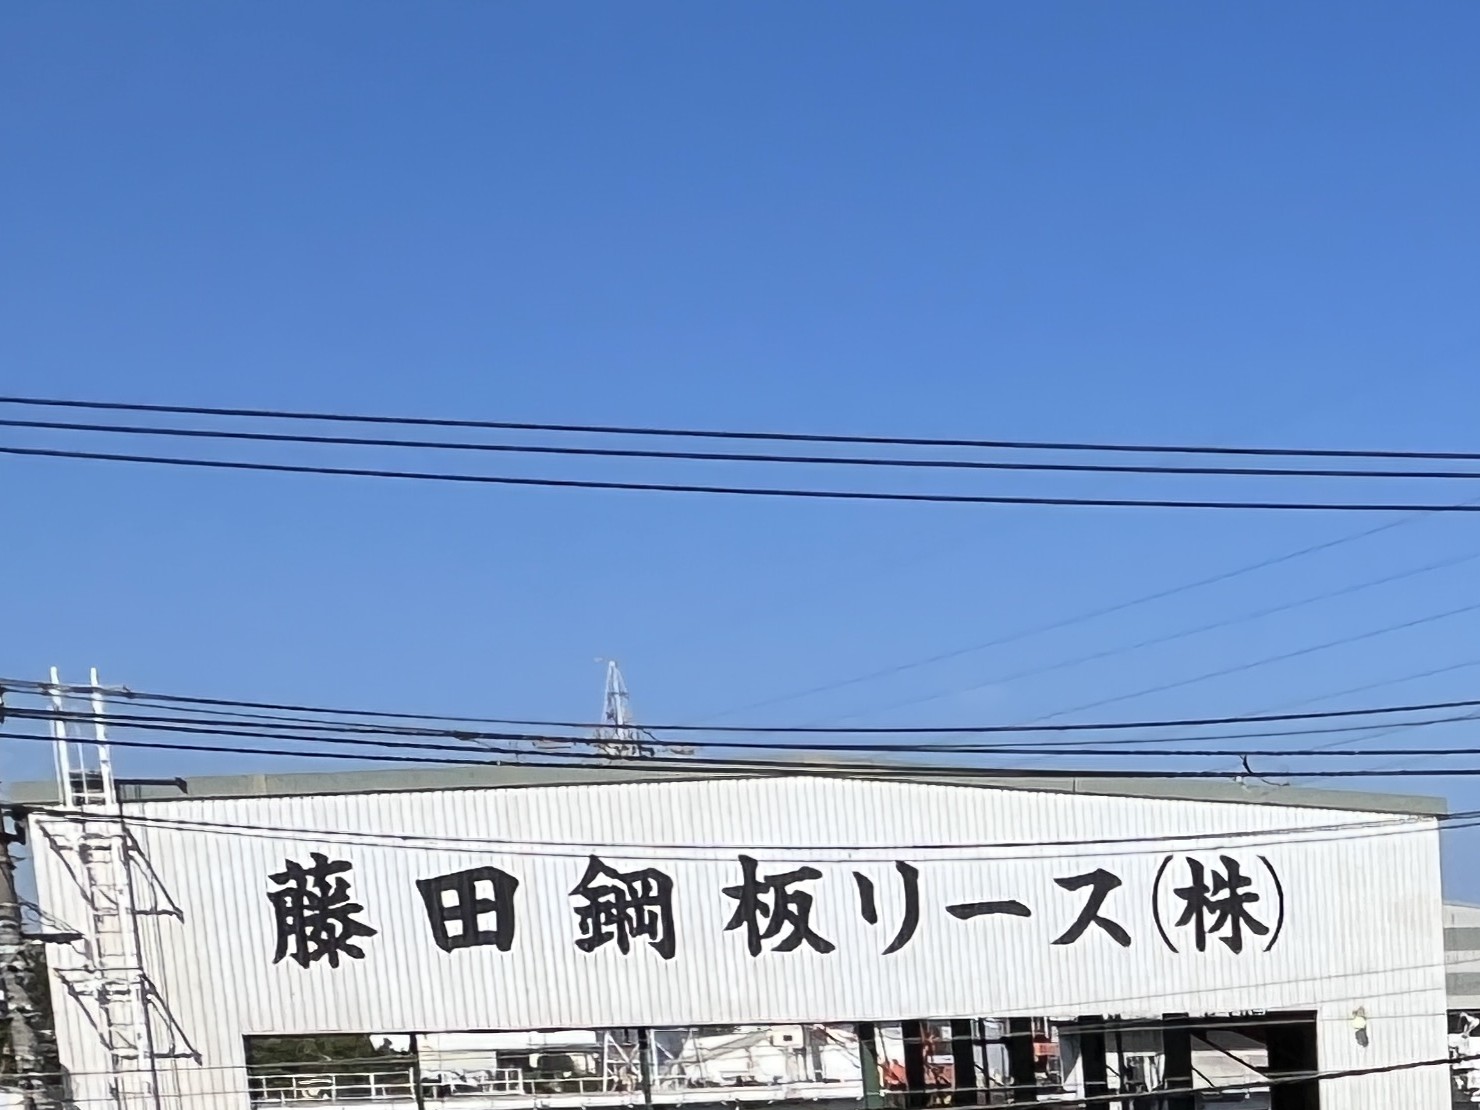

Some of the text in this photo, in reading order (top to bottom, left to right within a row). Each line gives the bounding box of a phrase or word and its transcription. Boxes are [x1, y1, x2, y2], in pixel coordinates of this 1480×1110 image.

[267, 850, 1286, 970] 藤田鋼板リース(株)
